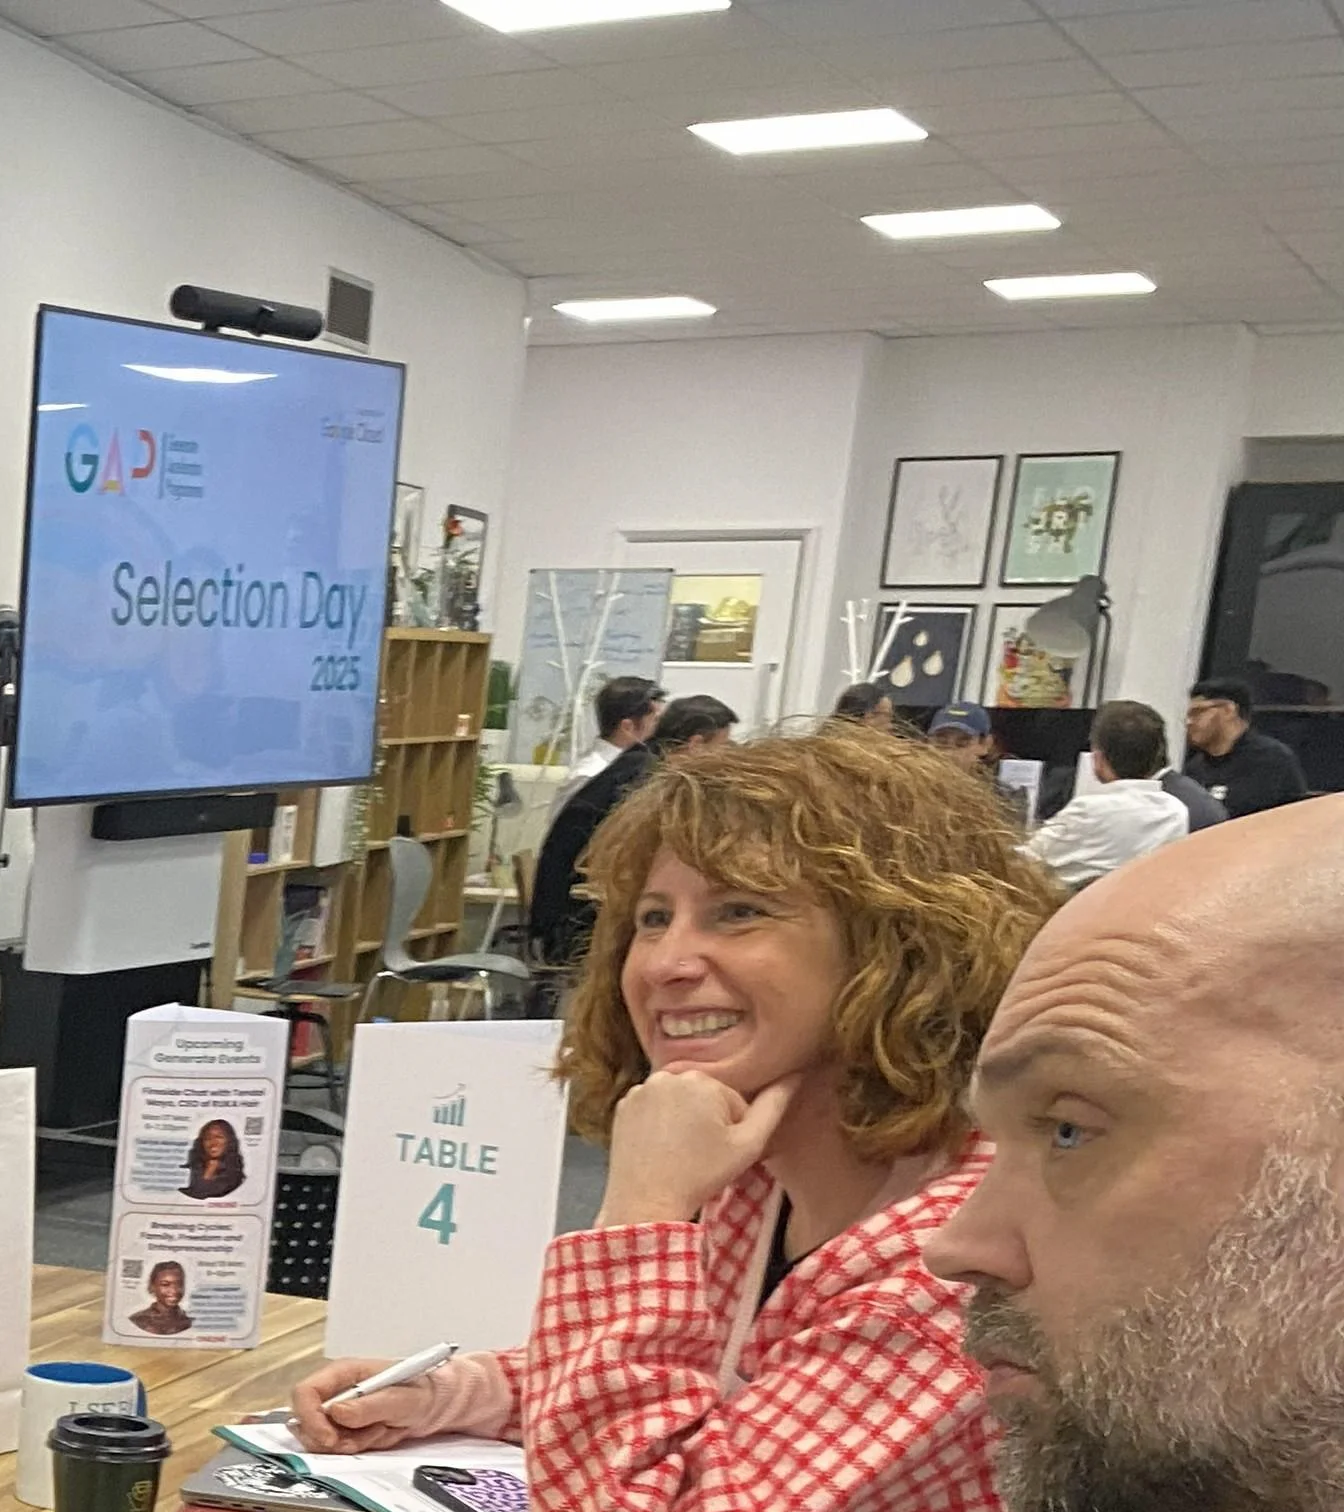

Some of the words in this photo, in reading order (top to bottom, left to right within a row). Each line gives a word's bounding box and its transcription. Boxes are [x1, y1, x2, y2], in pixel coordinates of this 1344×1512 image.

[113, 559, 288, 630] Selection
[299, 570, 367, 649] Day
[310, 655, 362, 692] 2025
[154, 1053, 216, 1063] Generate
[218, 1054, 261, 1064] Events
[176, 1039, 244, 1052] Upcoming
[395, 1132, 499, 1175] TABLE
[418, 1184, 458, 1246] 4
